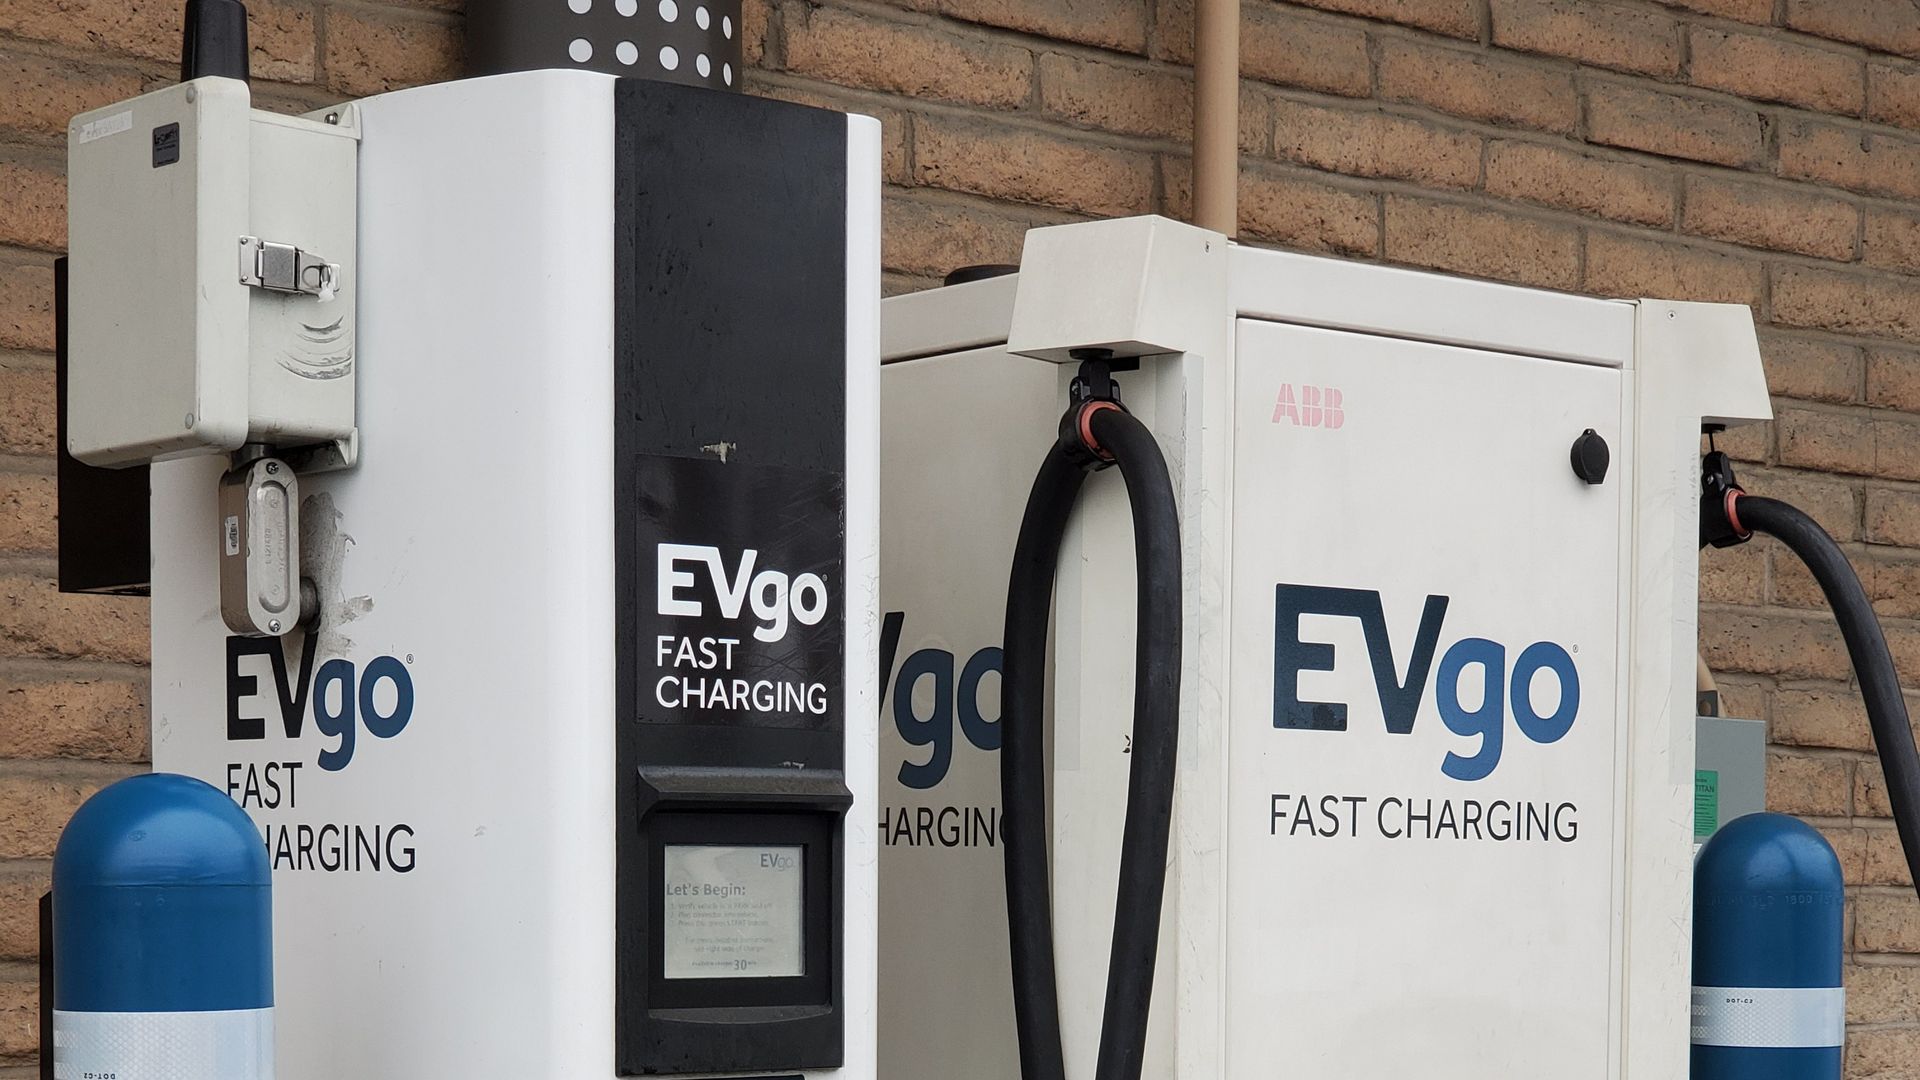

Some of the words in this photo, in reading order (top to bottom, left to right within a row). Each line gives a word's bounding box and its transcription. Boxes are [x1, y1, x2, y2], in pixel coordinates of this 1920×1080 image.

[1271, 383, 1345, 430] ABB
[656, 635, 741, 670] FAST
[655, 675, 828, 715] CHARGING
[226, 761, 304, 810] FAST
[1270, 793, 1368, 838] FAST
[1376, 796, 1579, 843] CHARGING
[666, 882, 700, 896] Let's
[702, 882, 747, 899] Begin:
[733, 959, 748, 971] 30
[83, 1072, 116, 1080] DOT-C2
